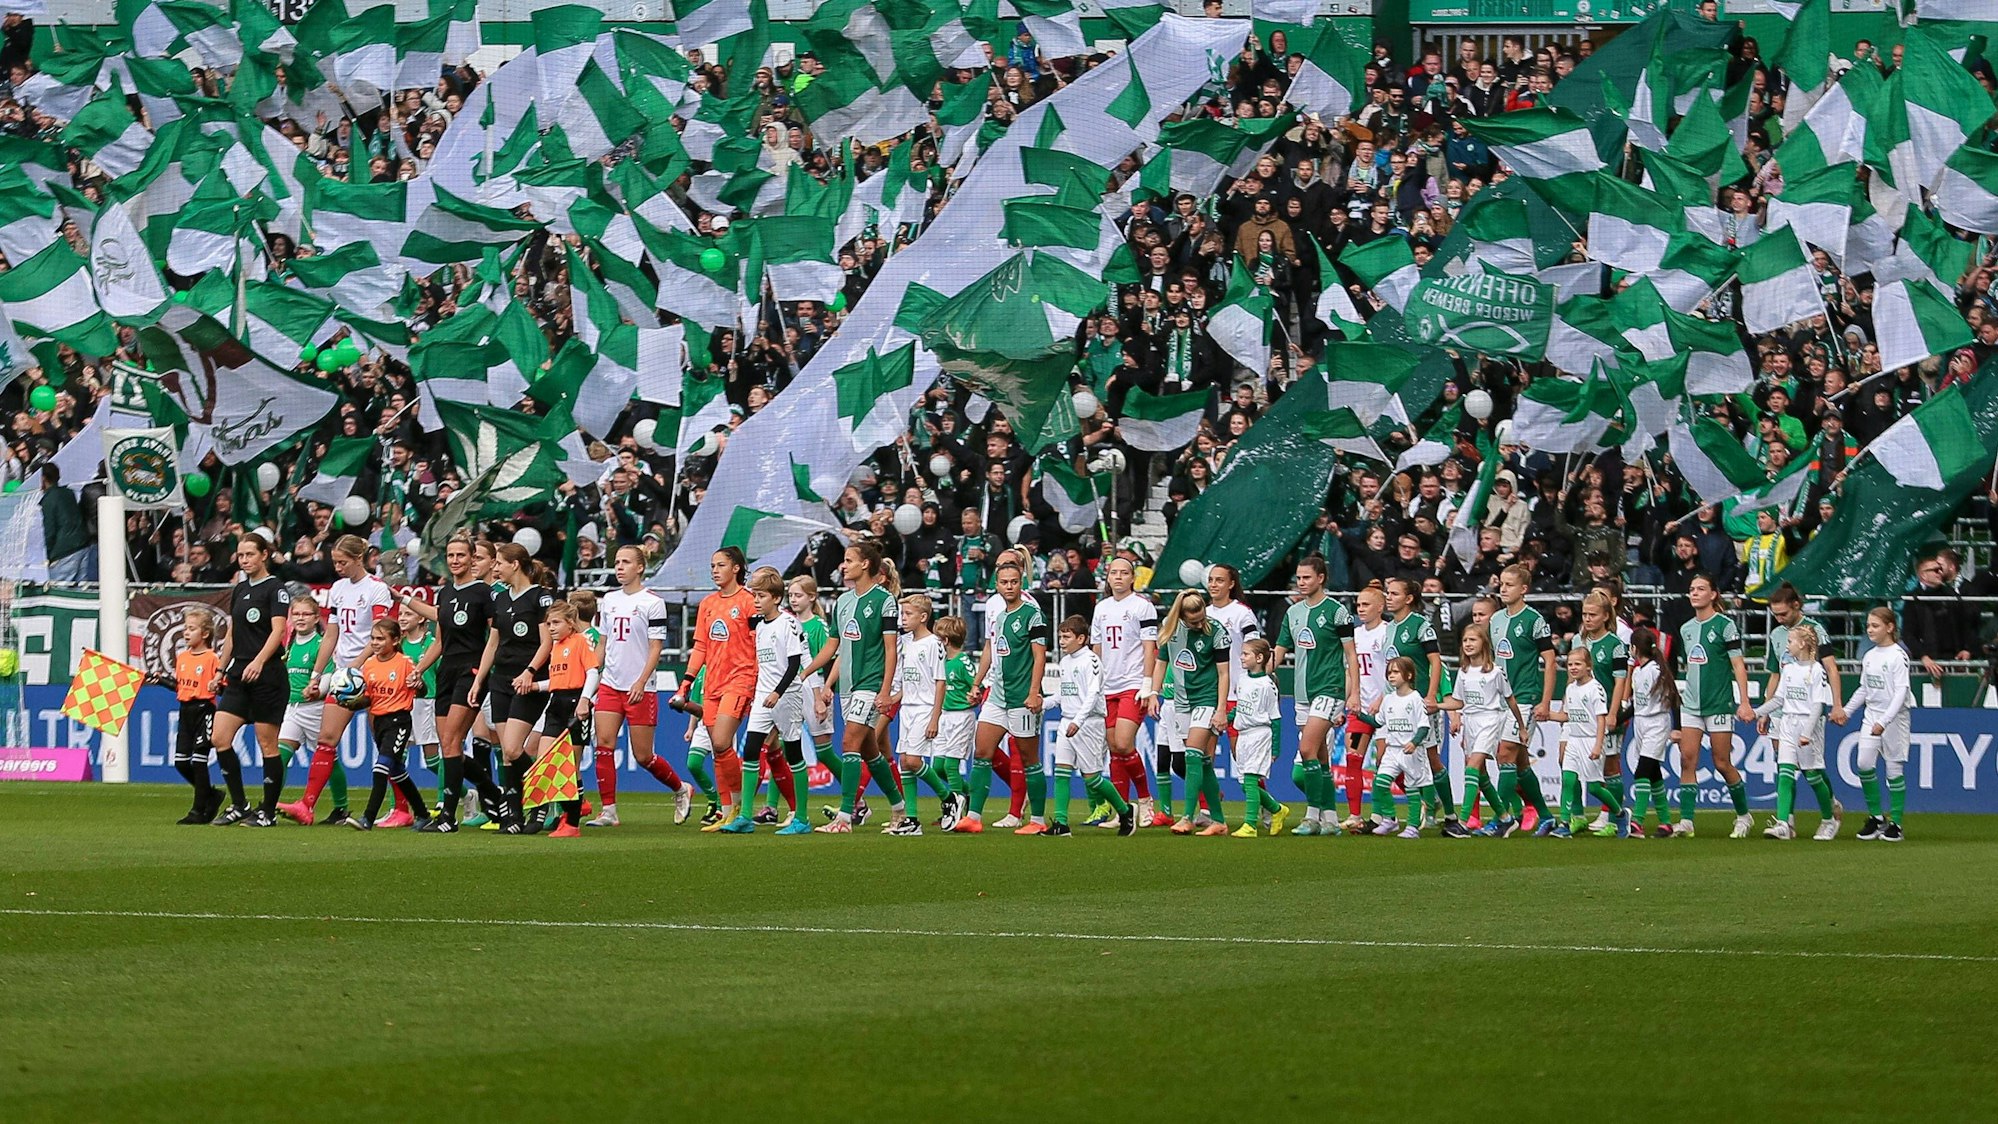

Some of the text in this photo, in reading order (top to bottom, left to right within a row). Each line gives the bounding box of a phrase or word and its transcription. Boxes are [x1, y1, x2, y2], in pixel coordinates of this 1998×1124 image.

[733, 695, 741, 711] 1
[850, 698, 866, 716] 23
[1315, 696, 1329, 712] 21
[1193, 706, 1207, 721] 27
[1022, 714, 1030, 731] 11
[1837, 732, 1994, 789] CTY
